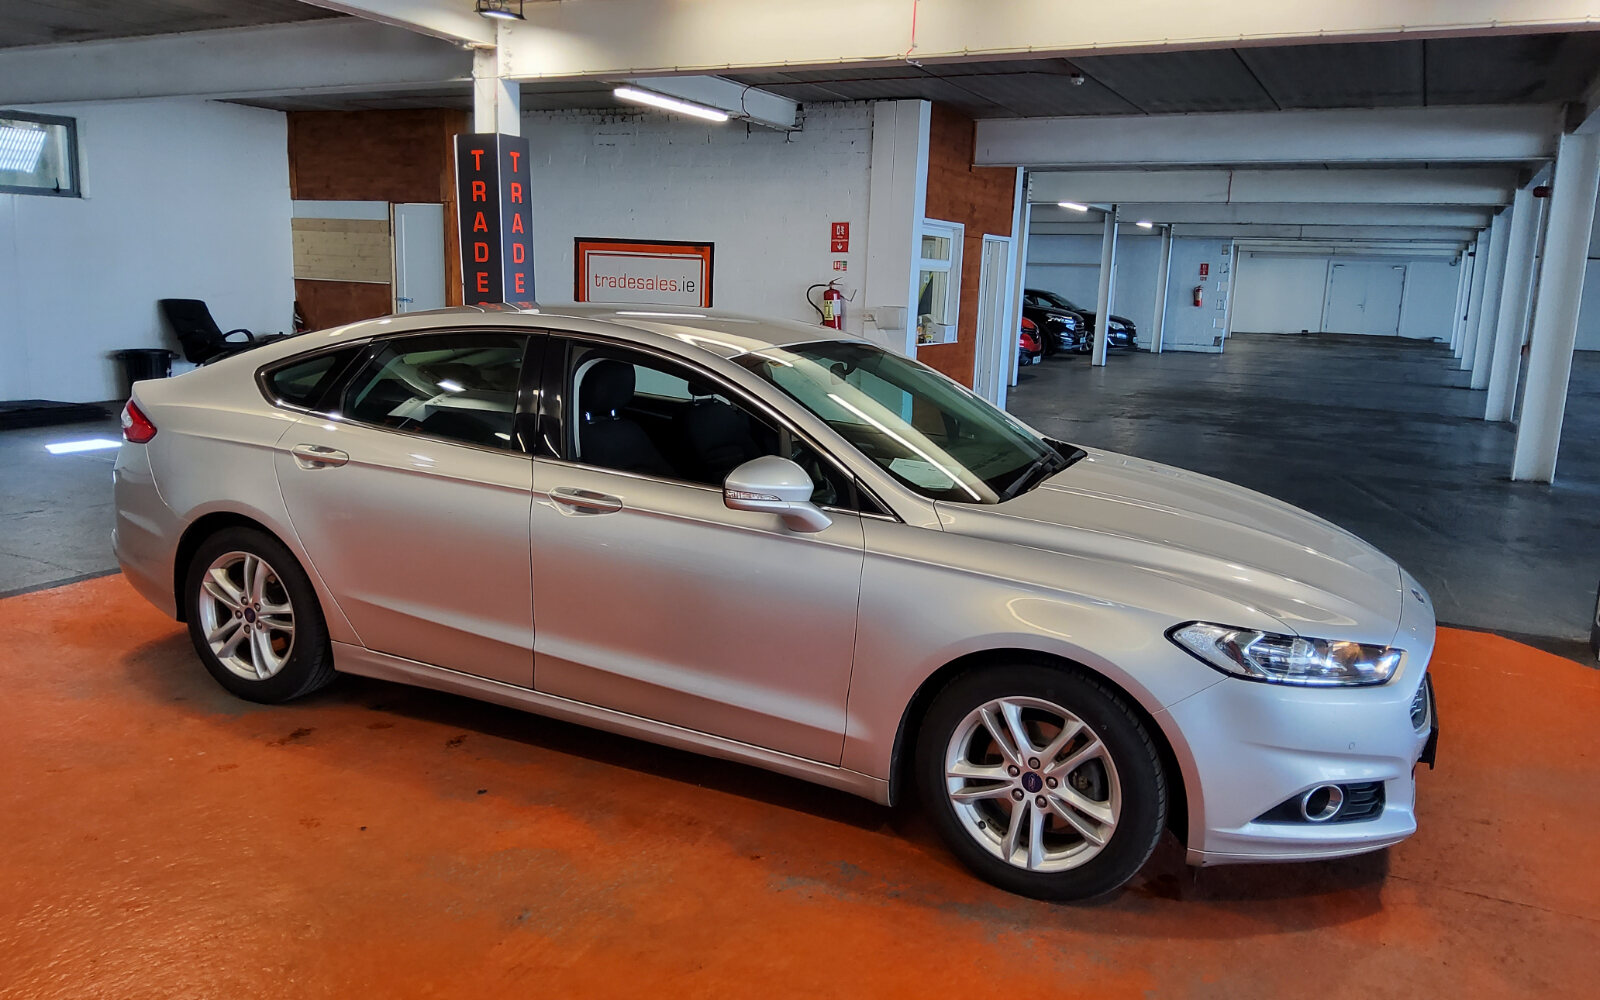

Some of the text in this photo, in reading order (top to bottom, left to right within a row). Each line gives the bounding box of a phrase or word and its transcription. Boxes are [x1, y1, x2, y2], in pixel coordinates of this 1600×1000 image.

[470, 149, 490, 305] TRADE
[509, 151, 526, 294] TRADE
[594, 272, 696, 293] tradesales.ie
